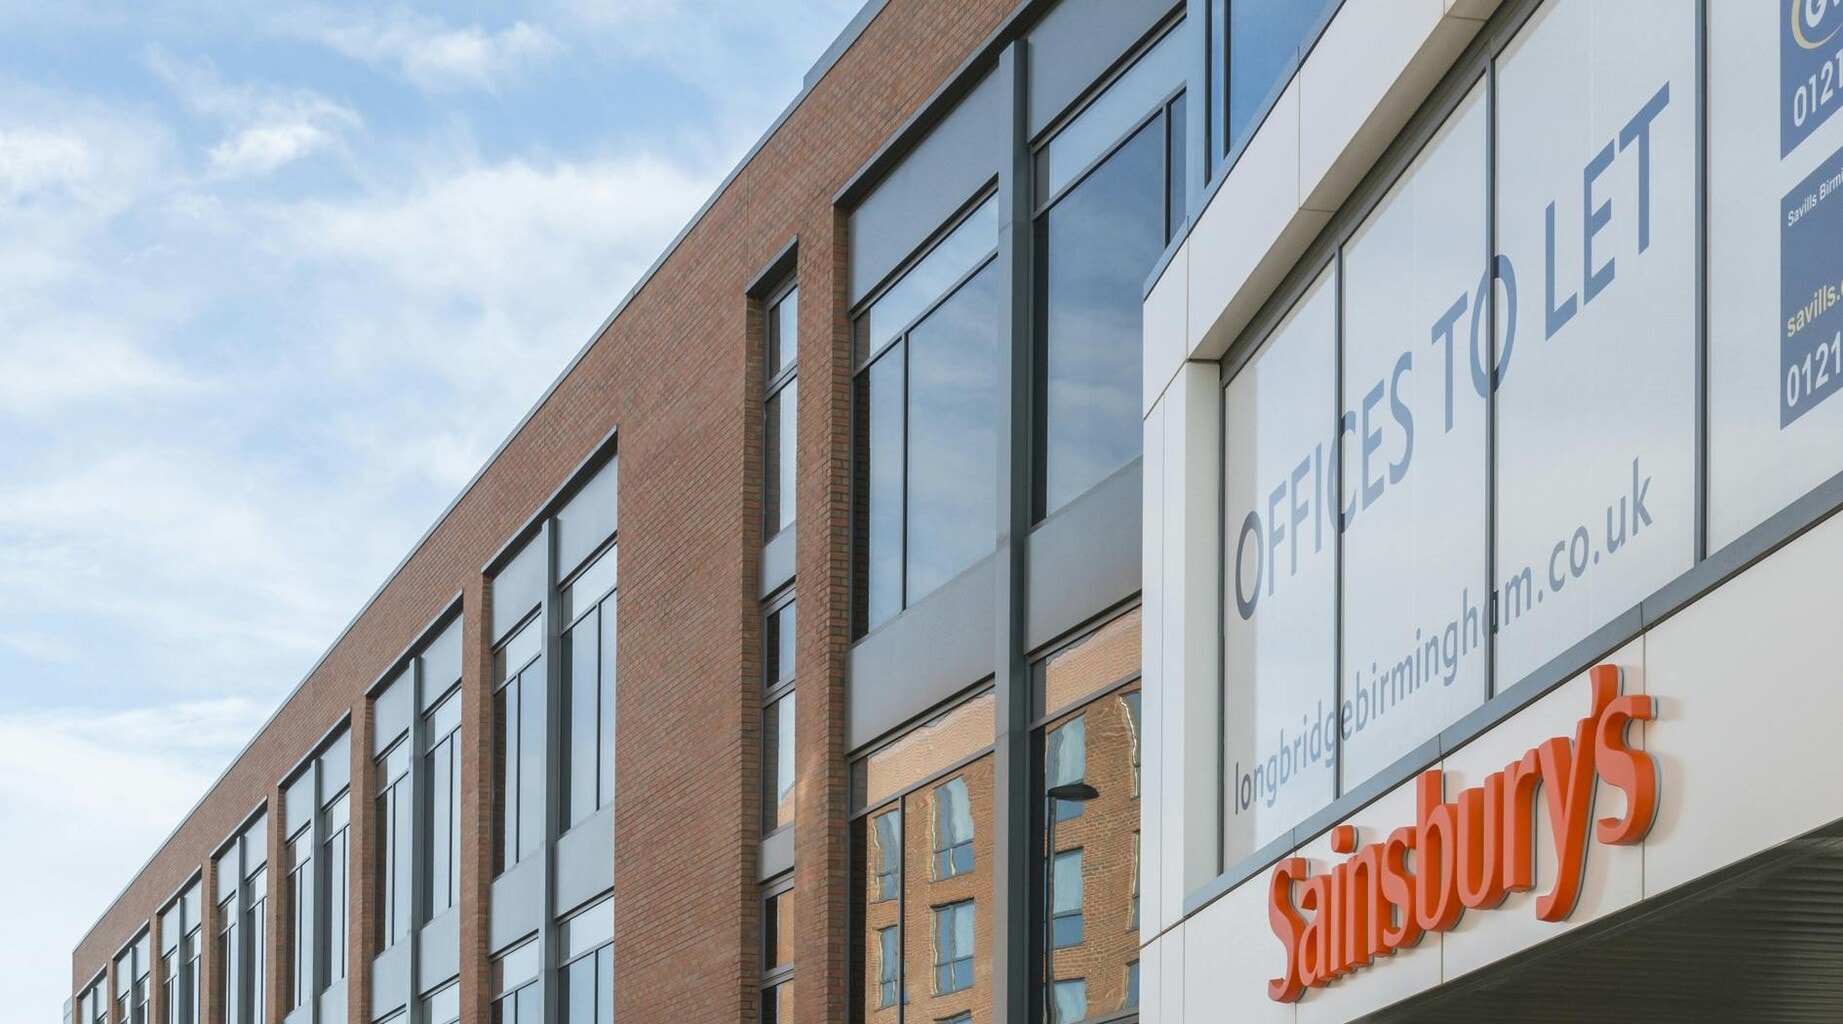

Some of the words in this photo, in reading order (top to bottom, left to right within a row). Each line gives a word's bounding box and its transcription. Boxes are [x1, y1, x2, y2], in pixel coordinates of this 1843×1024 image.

[1794, 48, 1843, 127] 0121
[1788, 194, 1818, 227] Savills
[1787, 280, 1843, 338] savills.
[1235, 351, 1415, 621] OFFICES
[1431, 254, 1518, 435] TO
[1544, 80, 1671, 342] LET
[1787, 330, 1842, 408] 0121
[1235, 456, 1654, 815] longbridgebirmingham.co.uk
[1268, 664, 1661, 1003] Sainsbury's
